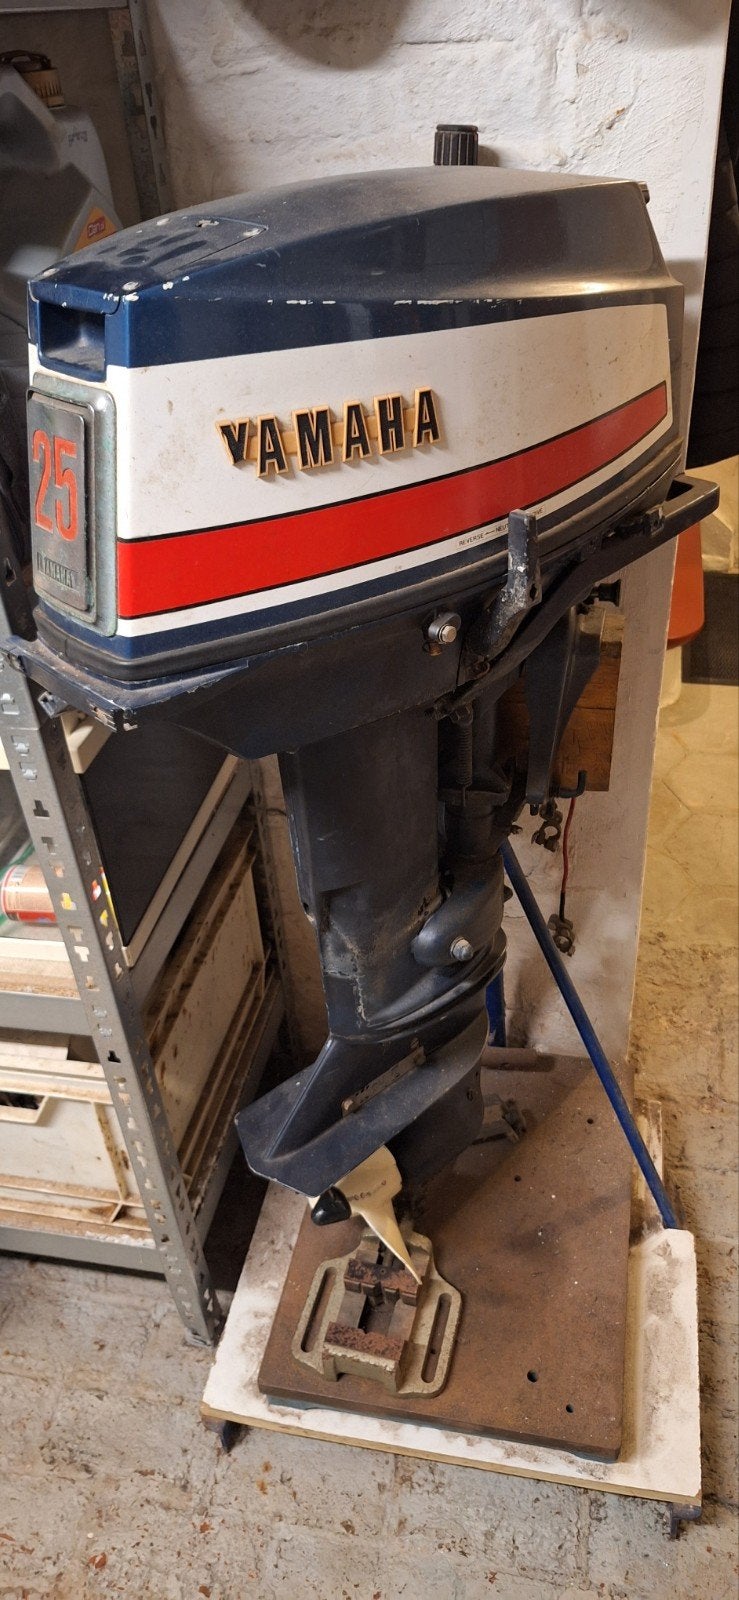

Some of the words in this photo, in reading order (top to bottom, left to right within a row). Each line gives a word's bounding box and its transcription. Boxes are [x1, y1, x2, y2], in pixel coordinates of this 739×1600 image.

[216, 386, 440, 477] YAMAHA
[32, 429, 77, 542] 25
[459, 533, 484, 546] REVERSE
